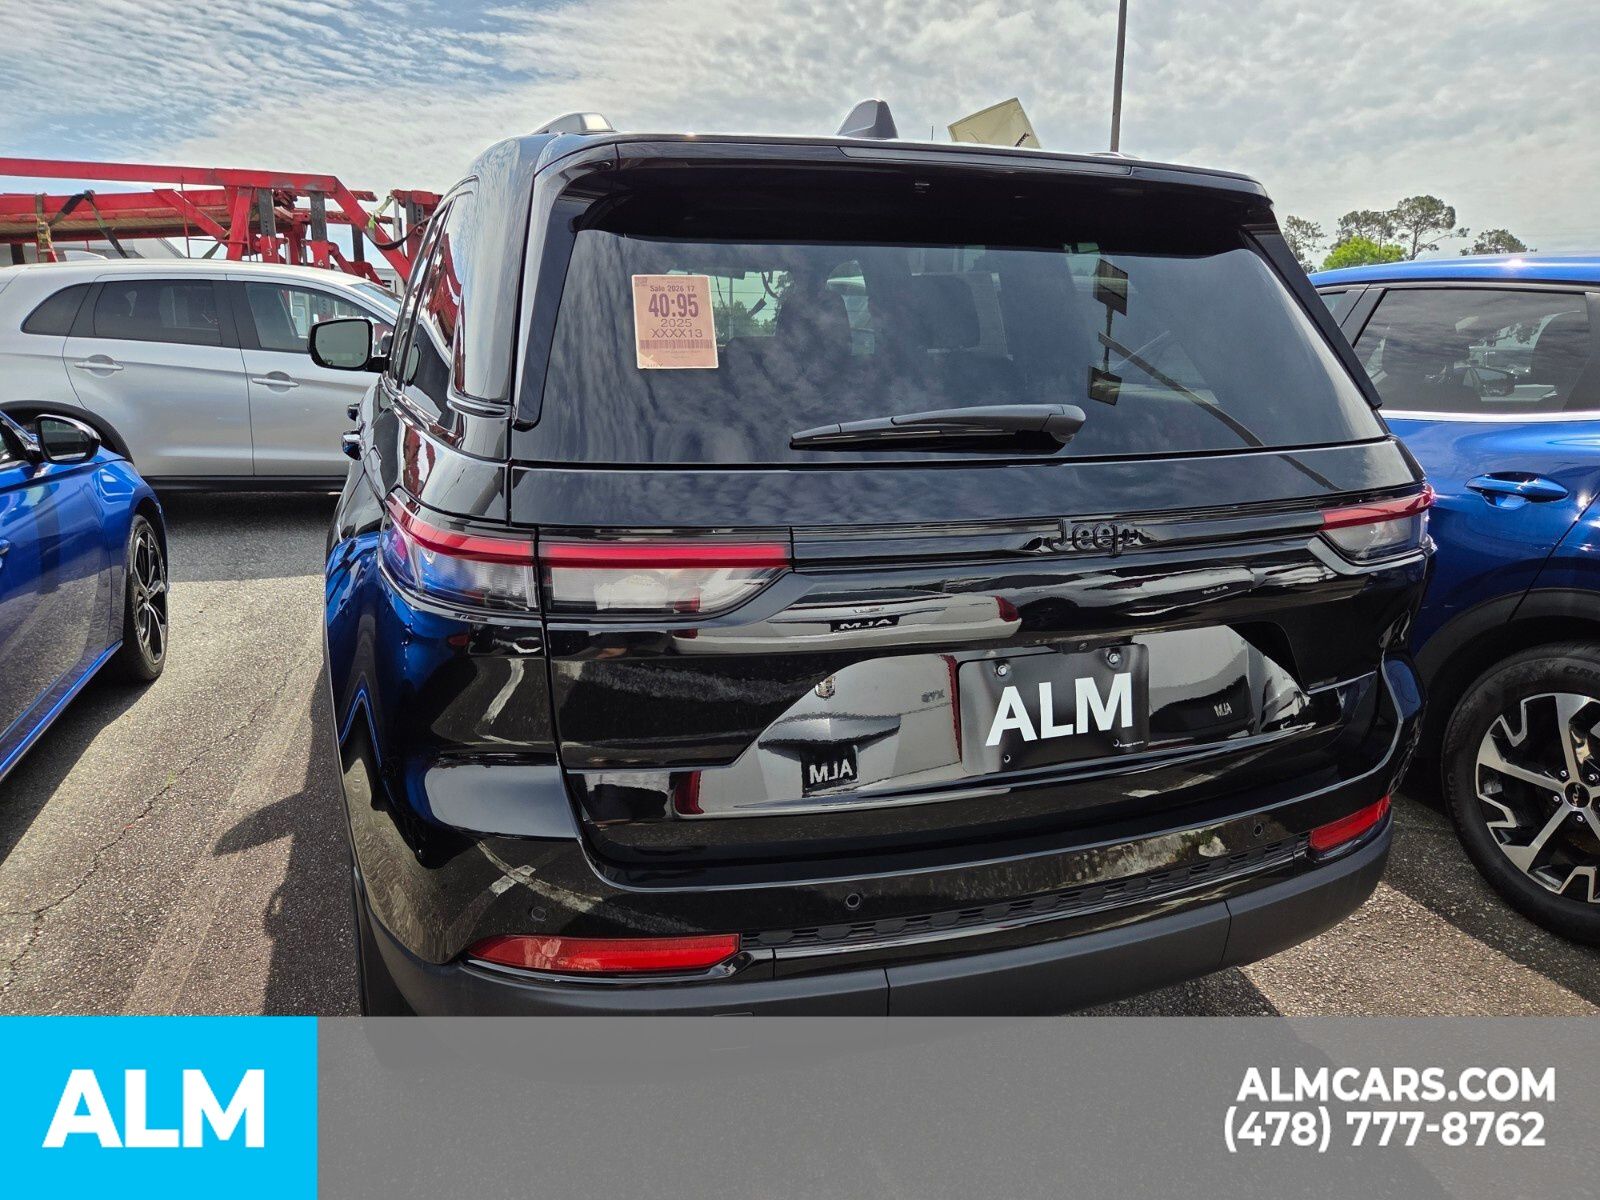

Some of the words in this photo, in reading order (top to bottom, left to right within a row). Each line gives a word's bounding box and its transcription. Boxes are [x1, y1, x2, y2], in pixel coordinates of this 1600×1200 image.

[648, 293, 699, 317] 40:95
[651, 328, 703, 338] XXXX13
[660, 318, 693, 328] 2025
[1049, 518, 1136, 556] Jeep
[985, 672, 1133, 747] ALM
